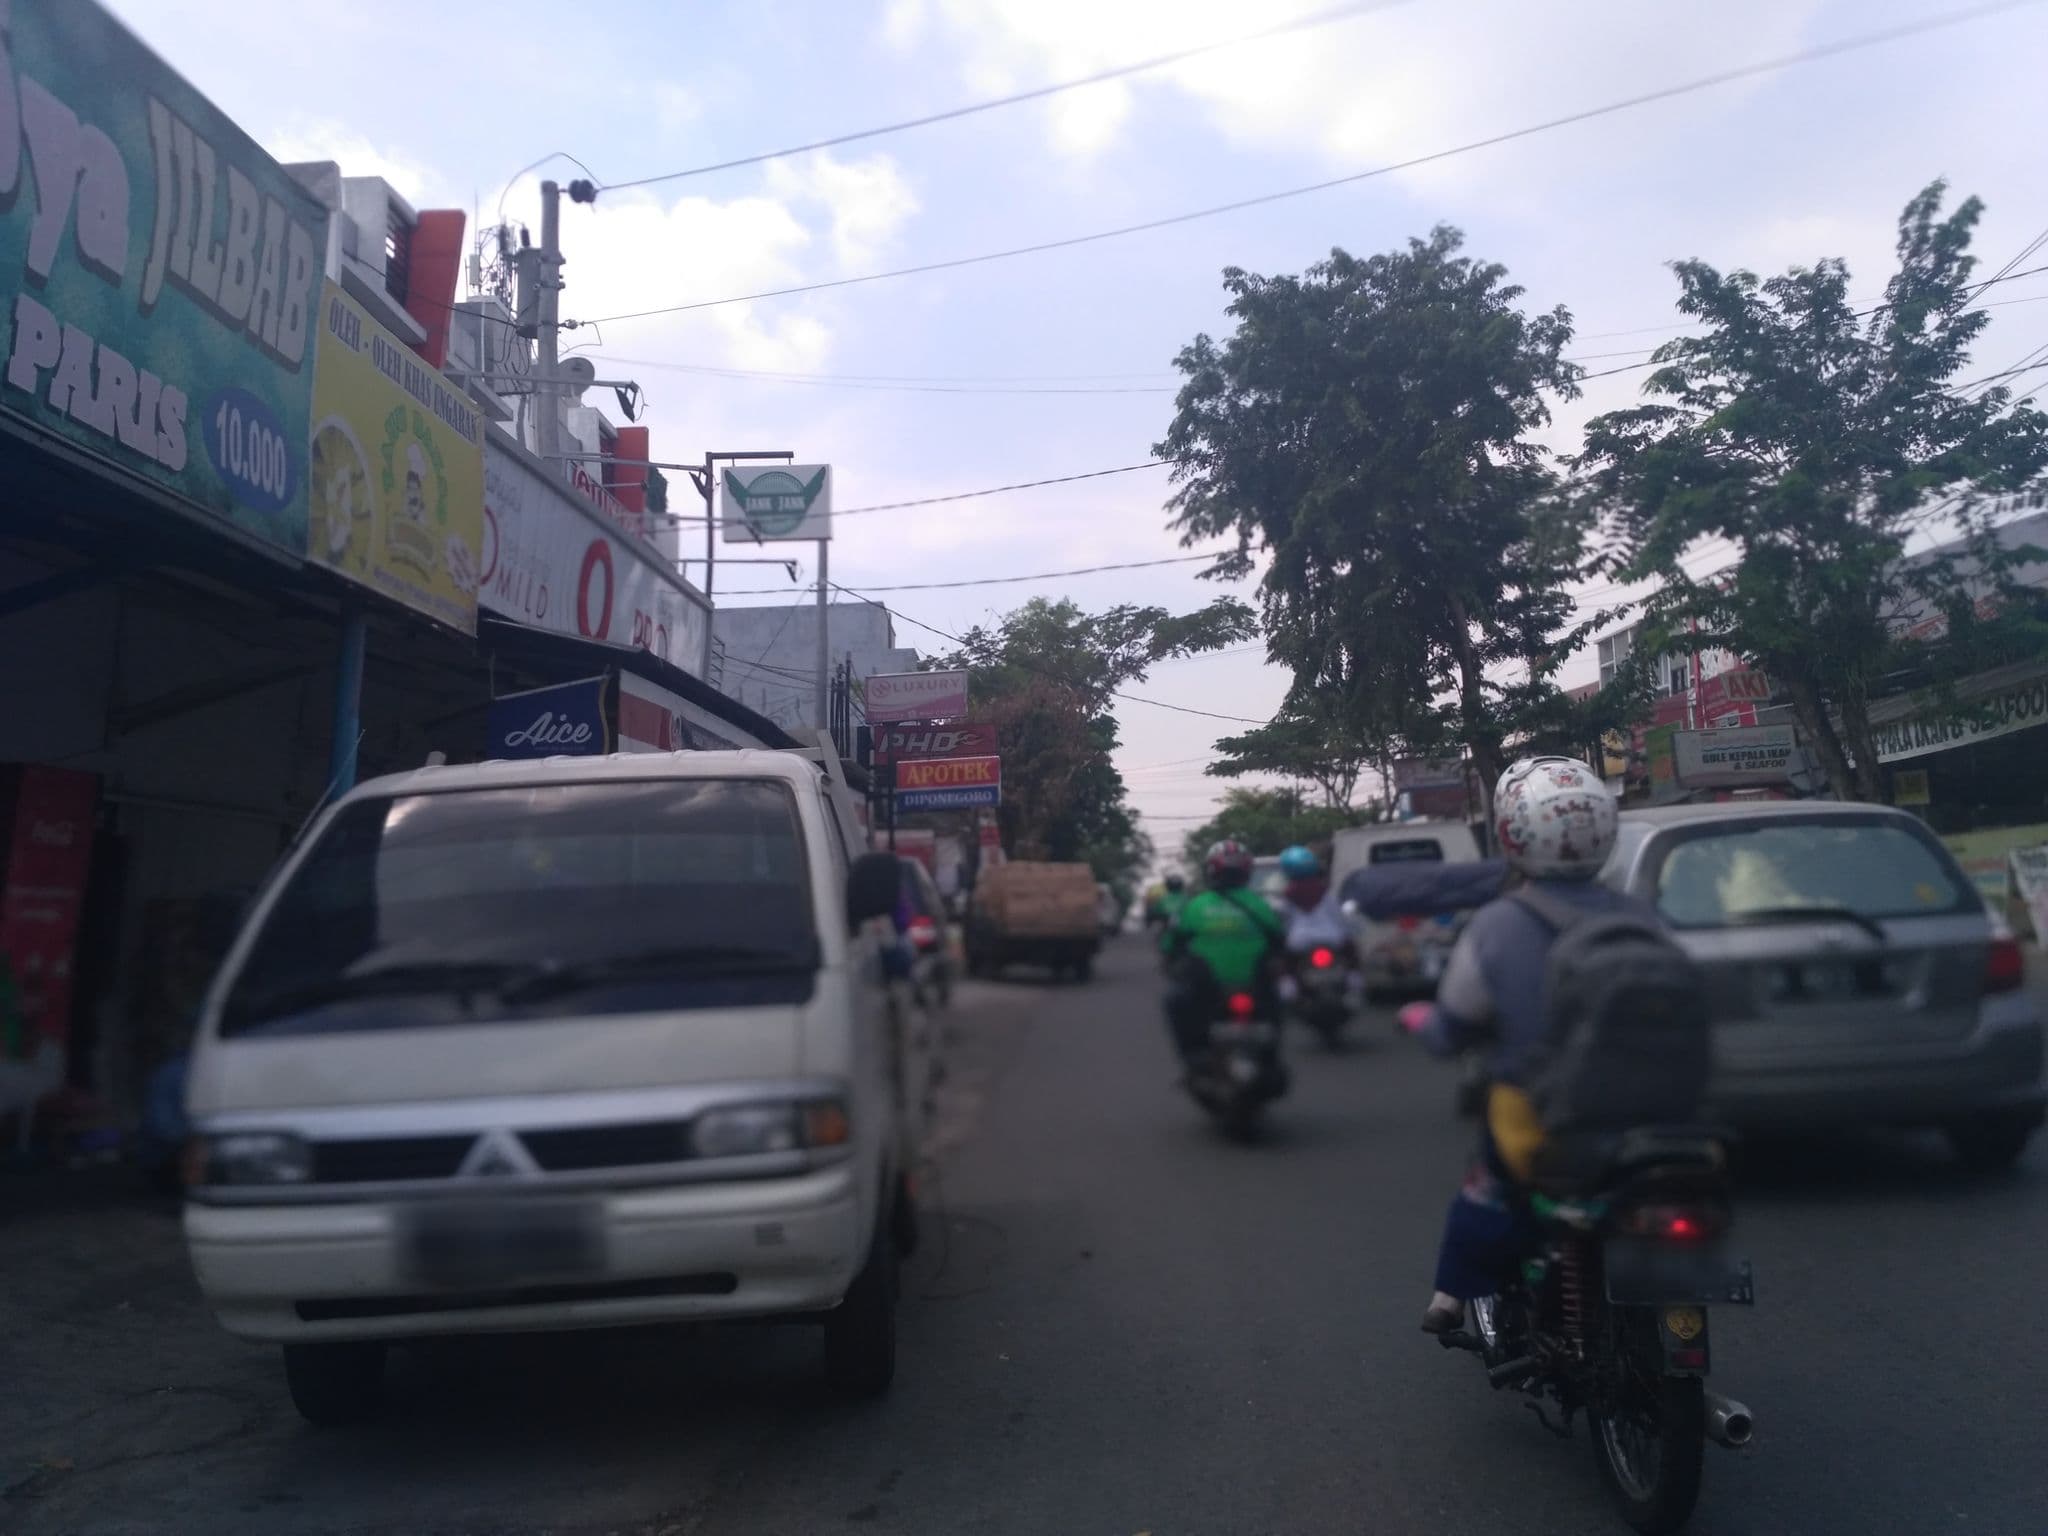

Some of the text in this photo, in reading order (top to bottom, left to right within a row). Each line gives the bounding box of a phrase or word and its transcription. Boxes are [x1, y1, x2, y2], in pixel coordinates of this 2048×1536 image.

[142, 95, 314, 363] JILBAB
[329, 297, 361, 352] OLEH
[373, 335, 402, 385] OLEH
[404, 358, 432, 408] KHAS
[8, 291, 188, 471] PARIS
[216, 400, 286, 499] 10.000
[497, 565, 548, 619] MILD
[892, 677, 960, 693] LUXURY
[1728, 673, 1769, 698] AKI
[505, 712, 592, 747] Aice
[878, 730, 962, 752] PHD
[1729, 749, 1765, 761] KEPALA
[906, 761, 992, 785] APOTEK
[904, 790, 993, 806] DIPONEGORO
